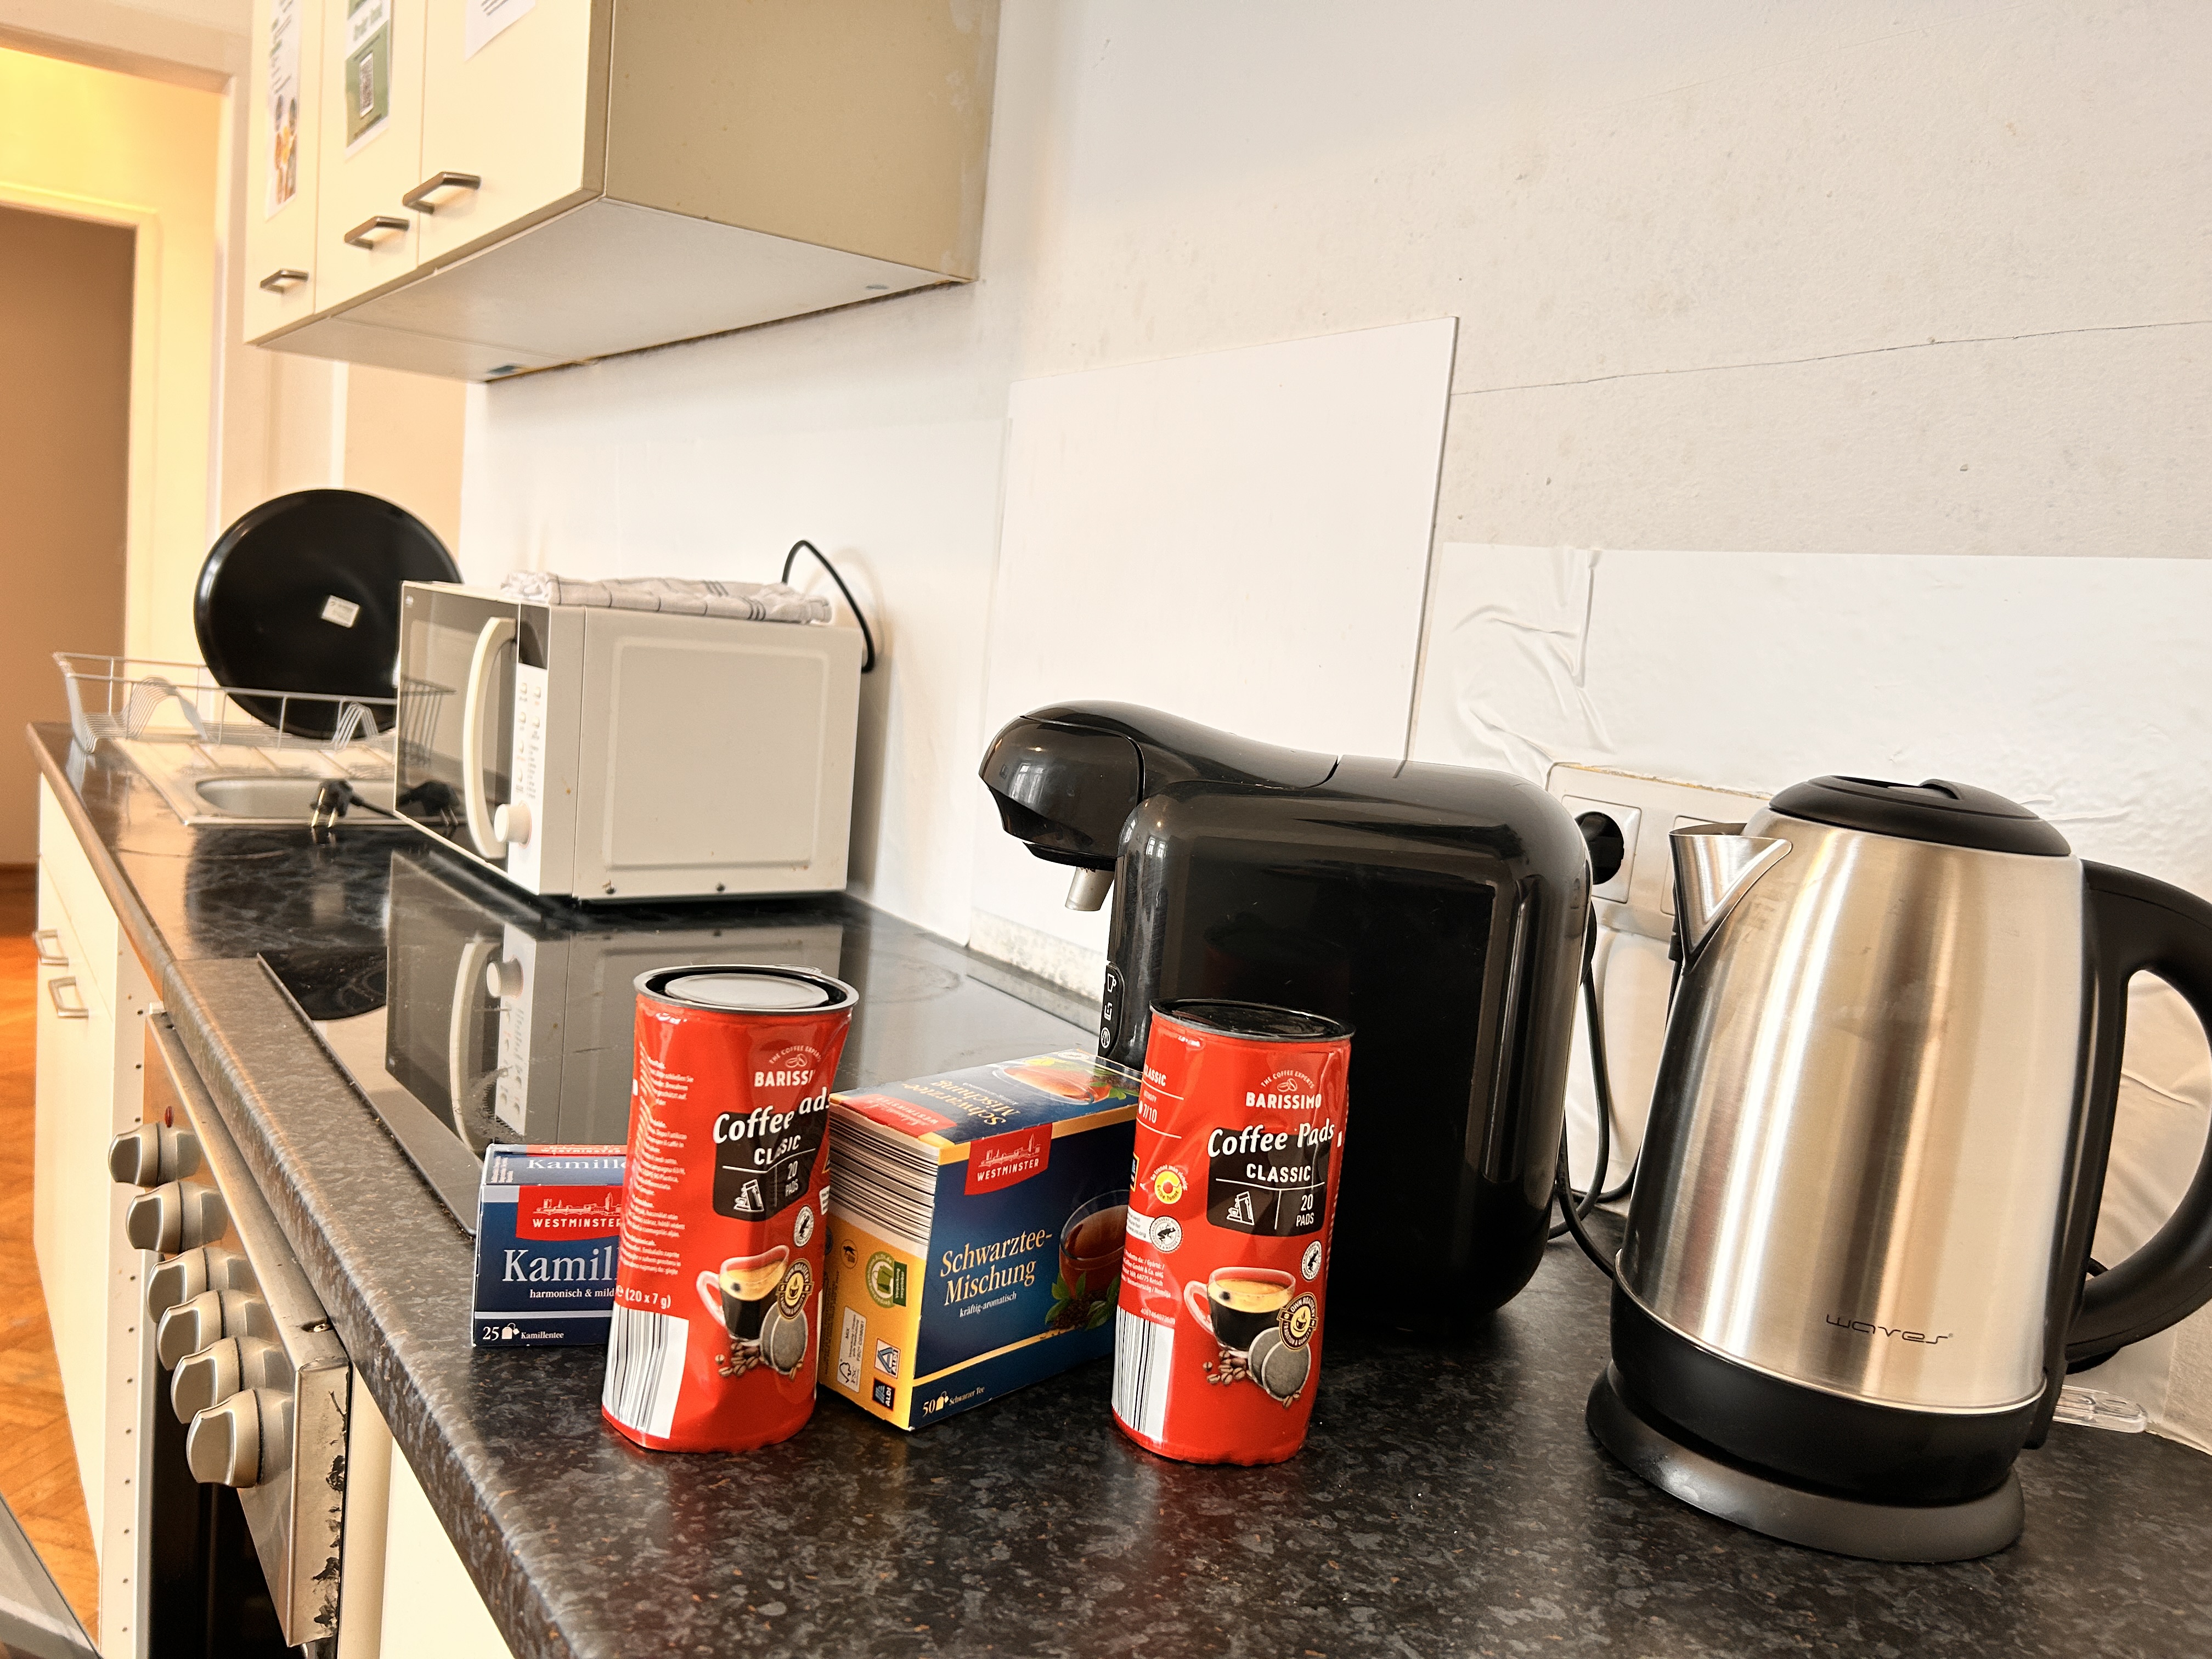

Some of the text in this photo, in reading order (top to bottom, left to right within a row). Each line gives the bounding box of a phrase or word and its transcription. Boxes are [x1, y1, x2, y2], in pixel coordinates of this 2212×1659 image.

[769, 1052, 781, 1064] THE
[781, 1045, 804, 1057] COFFEE
[1261, 1070, 1315, 1089] THE COFFEE EXPERTS
[902, 1084, 1006, 1126] Schwarztee-
[931, 1080, 1021, 1117] Mischung
[1245, 1091, 1322, 1110] BARISSIMO
[713, 1086, 830, 1144] Coffee ad
[1207, 1124, 1289, 1158] Coffee
[1296, 1118, 1335, 1148] Pads
[787, 1160, 799, 1181] 20
[977, 1158, 1040, 1182] WESTMINSTER
[1246, 1163, 1312, 1183] CLASSIC
[1300, 1193, 1314, 1211] 20
[1296, 1212, 1315, 1227] PADS
[502, 1246, 618, 1282] Kamil
[940, 1228, 1053, 1278] Schwarztee-
[529, 1289, 615, 1299] harmonisch & mild
[944, 1261, 1037, 1306] Mischung
[625, 1287, 642, 1302] (20
[644, 1293, 650, 1303] x
[652, 1293, 659, 1305] 7
[661, 1295, 672, 1310] g)
[960, 1291, 1017, 1318] kräftig-aromatisch
[1290, 1299, 1302, 1313] OWN
[482, 1326, 565, 1340] 25 Kamillentee
[1826, 1314, 1948, 1345] waves
[891, 1348, 899, 1376] ALDI
[922, 1386, 985, 1418] 50 Schwarzer Tee
